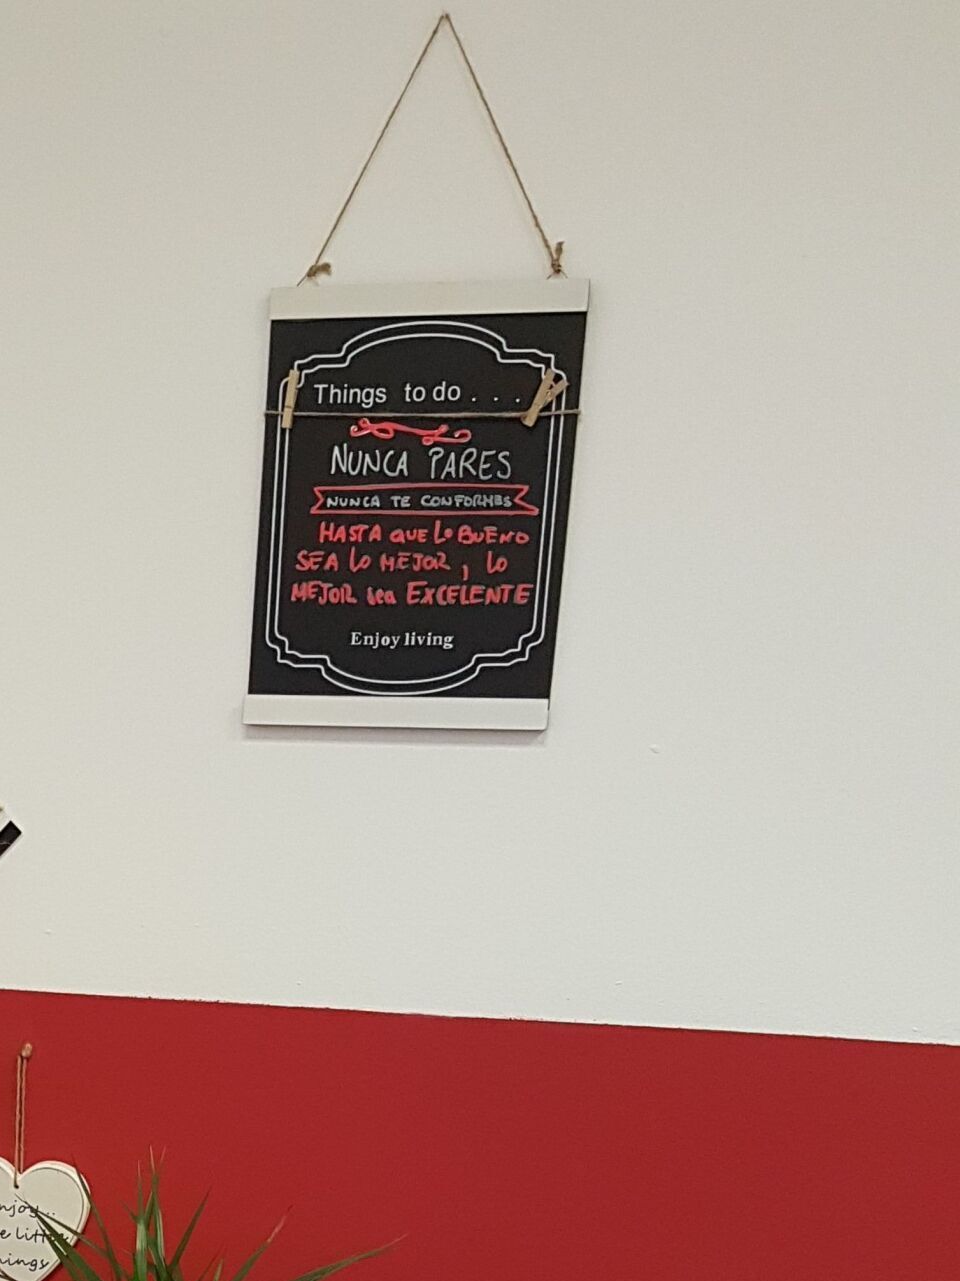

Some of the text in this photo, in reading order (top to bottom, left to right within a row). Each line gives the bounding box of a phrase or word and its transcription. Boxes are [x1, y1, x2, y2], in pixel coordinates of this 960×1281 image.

[313, 383, 387, 409] Things
[404, 382, 426, 402] to
[432, 381, 461, 402] do
[330, 442, 512, 481] NUNCA PARES
[325, 494, 381, 508] NUNCA
[391, 494, 411, 508] TE
[319, 521, 382, 544] HASTA
[295, 549, 339, 572] SEA
[290, 580, 358, 605] MEJOR
[350, 631, 455, 650] Enjoy living
[15, 1226, 70, 1244] litt
